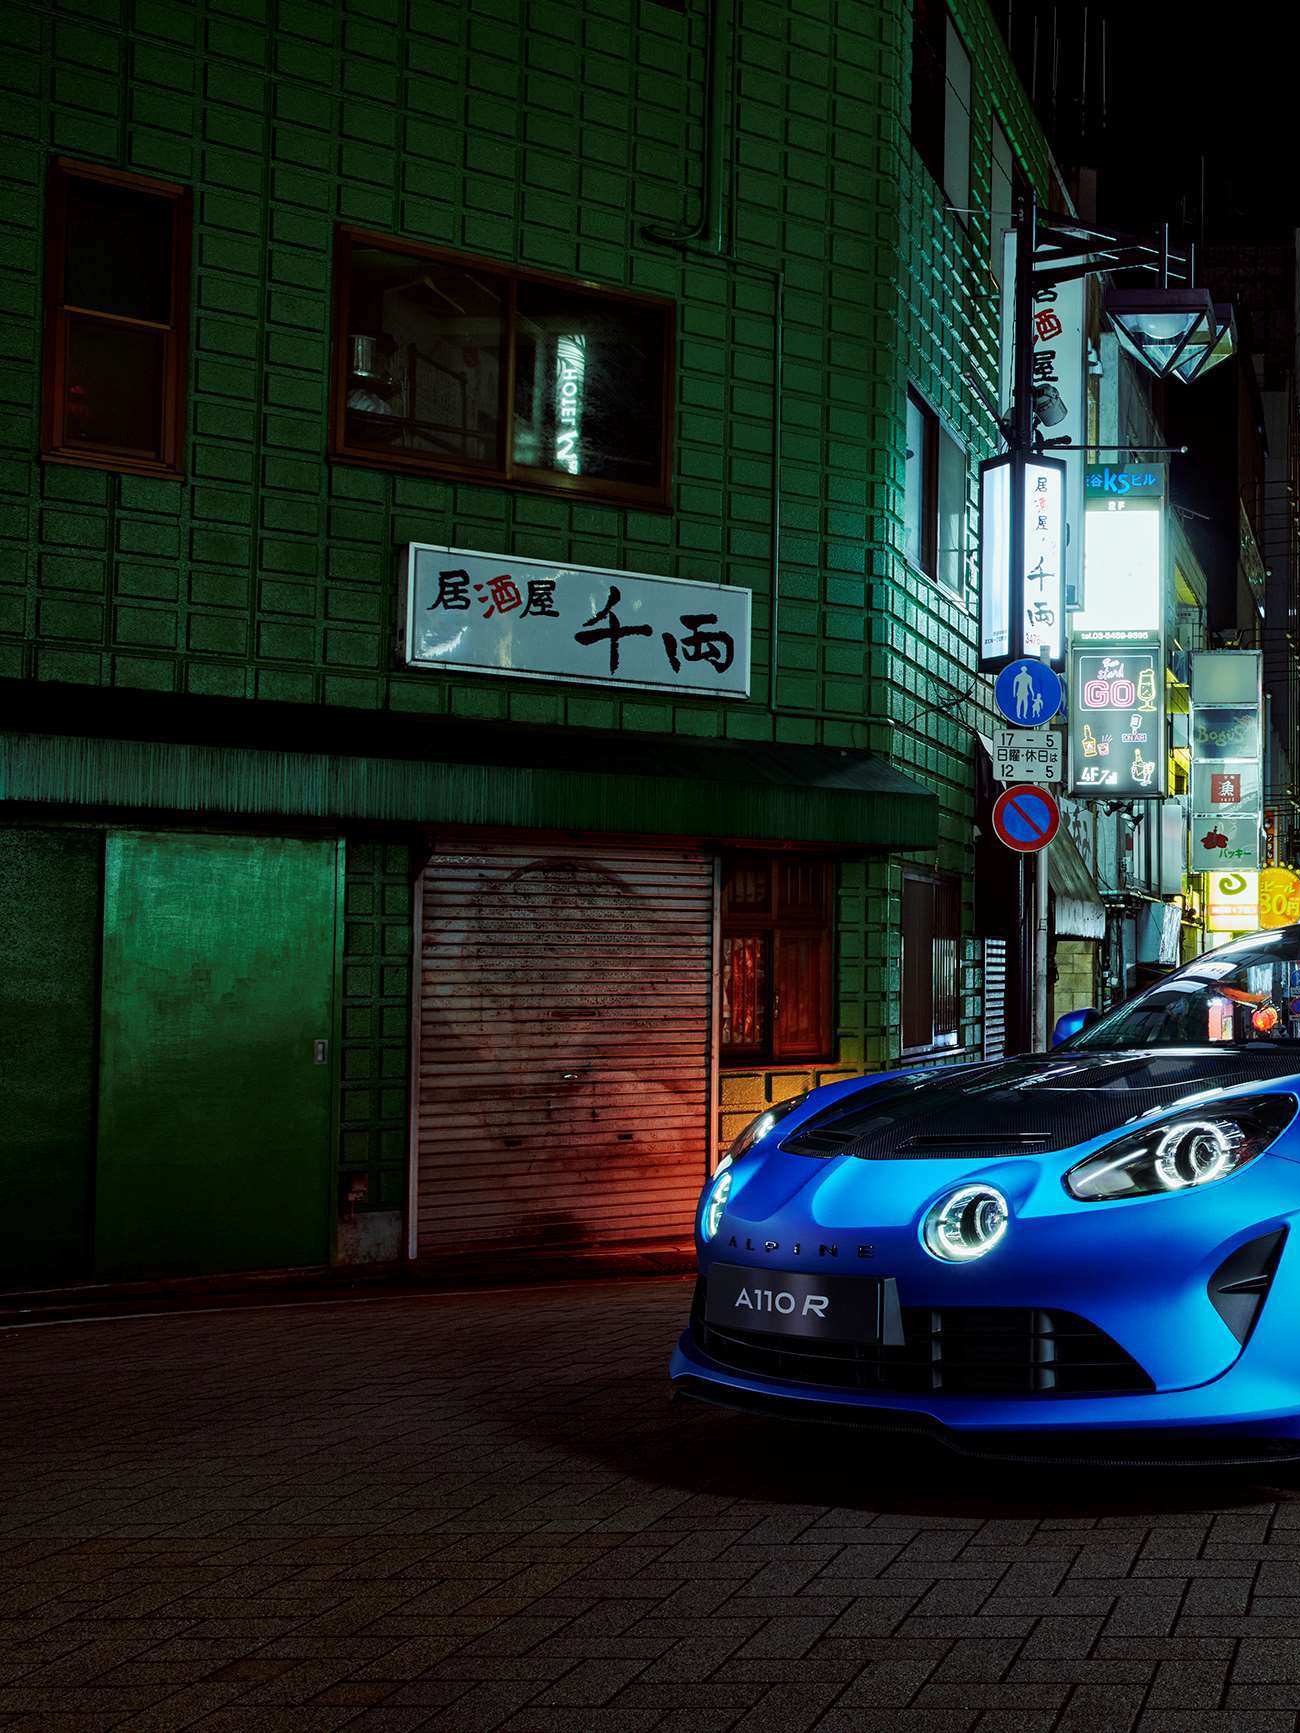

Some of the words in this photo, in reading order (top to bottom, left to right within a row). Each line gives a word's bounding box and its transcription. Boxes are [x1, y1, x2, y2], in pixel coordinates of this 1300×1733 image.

[426, 568, 560, 620] 居酒屋
[573, 585, 735, 676] 千両
[1084, 679, 1135, 708] GO
[1001, 732, 1015, 746] 17
[1046, 734, 1055, 748] 5
[1001, 764, 1014, 778] 12
[1045, 765, 1054, 779] 5
[1081, 766, 1099, 782] 4F
[729, 1236, 875, 1258] ALPINE
[735, 1288, 796, 1315] A110
[802, 1295, 830, 1318] R
